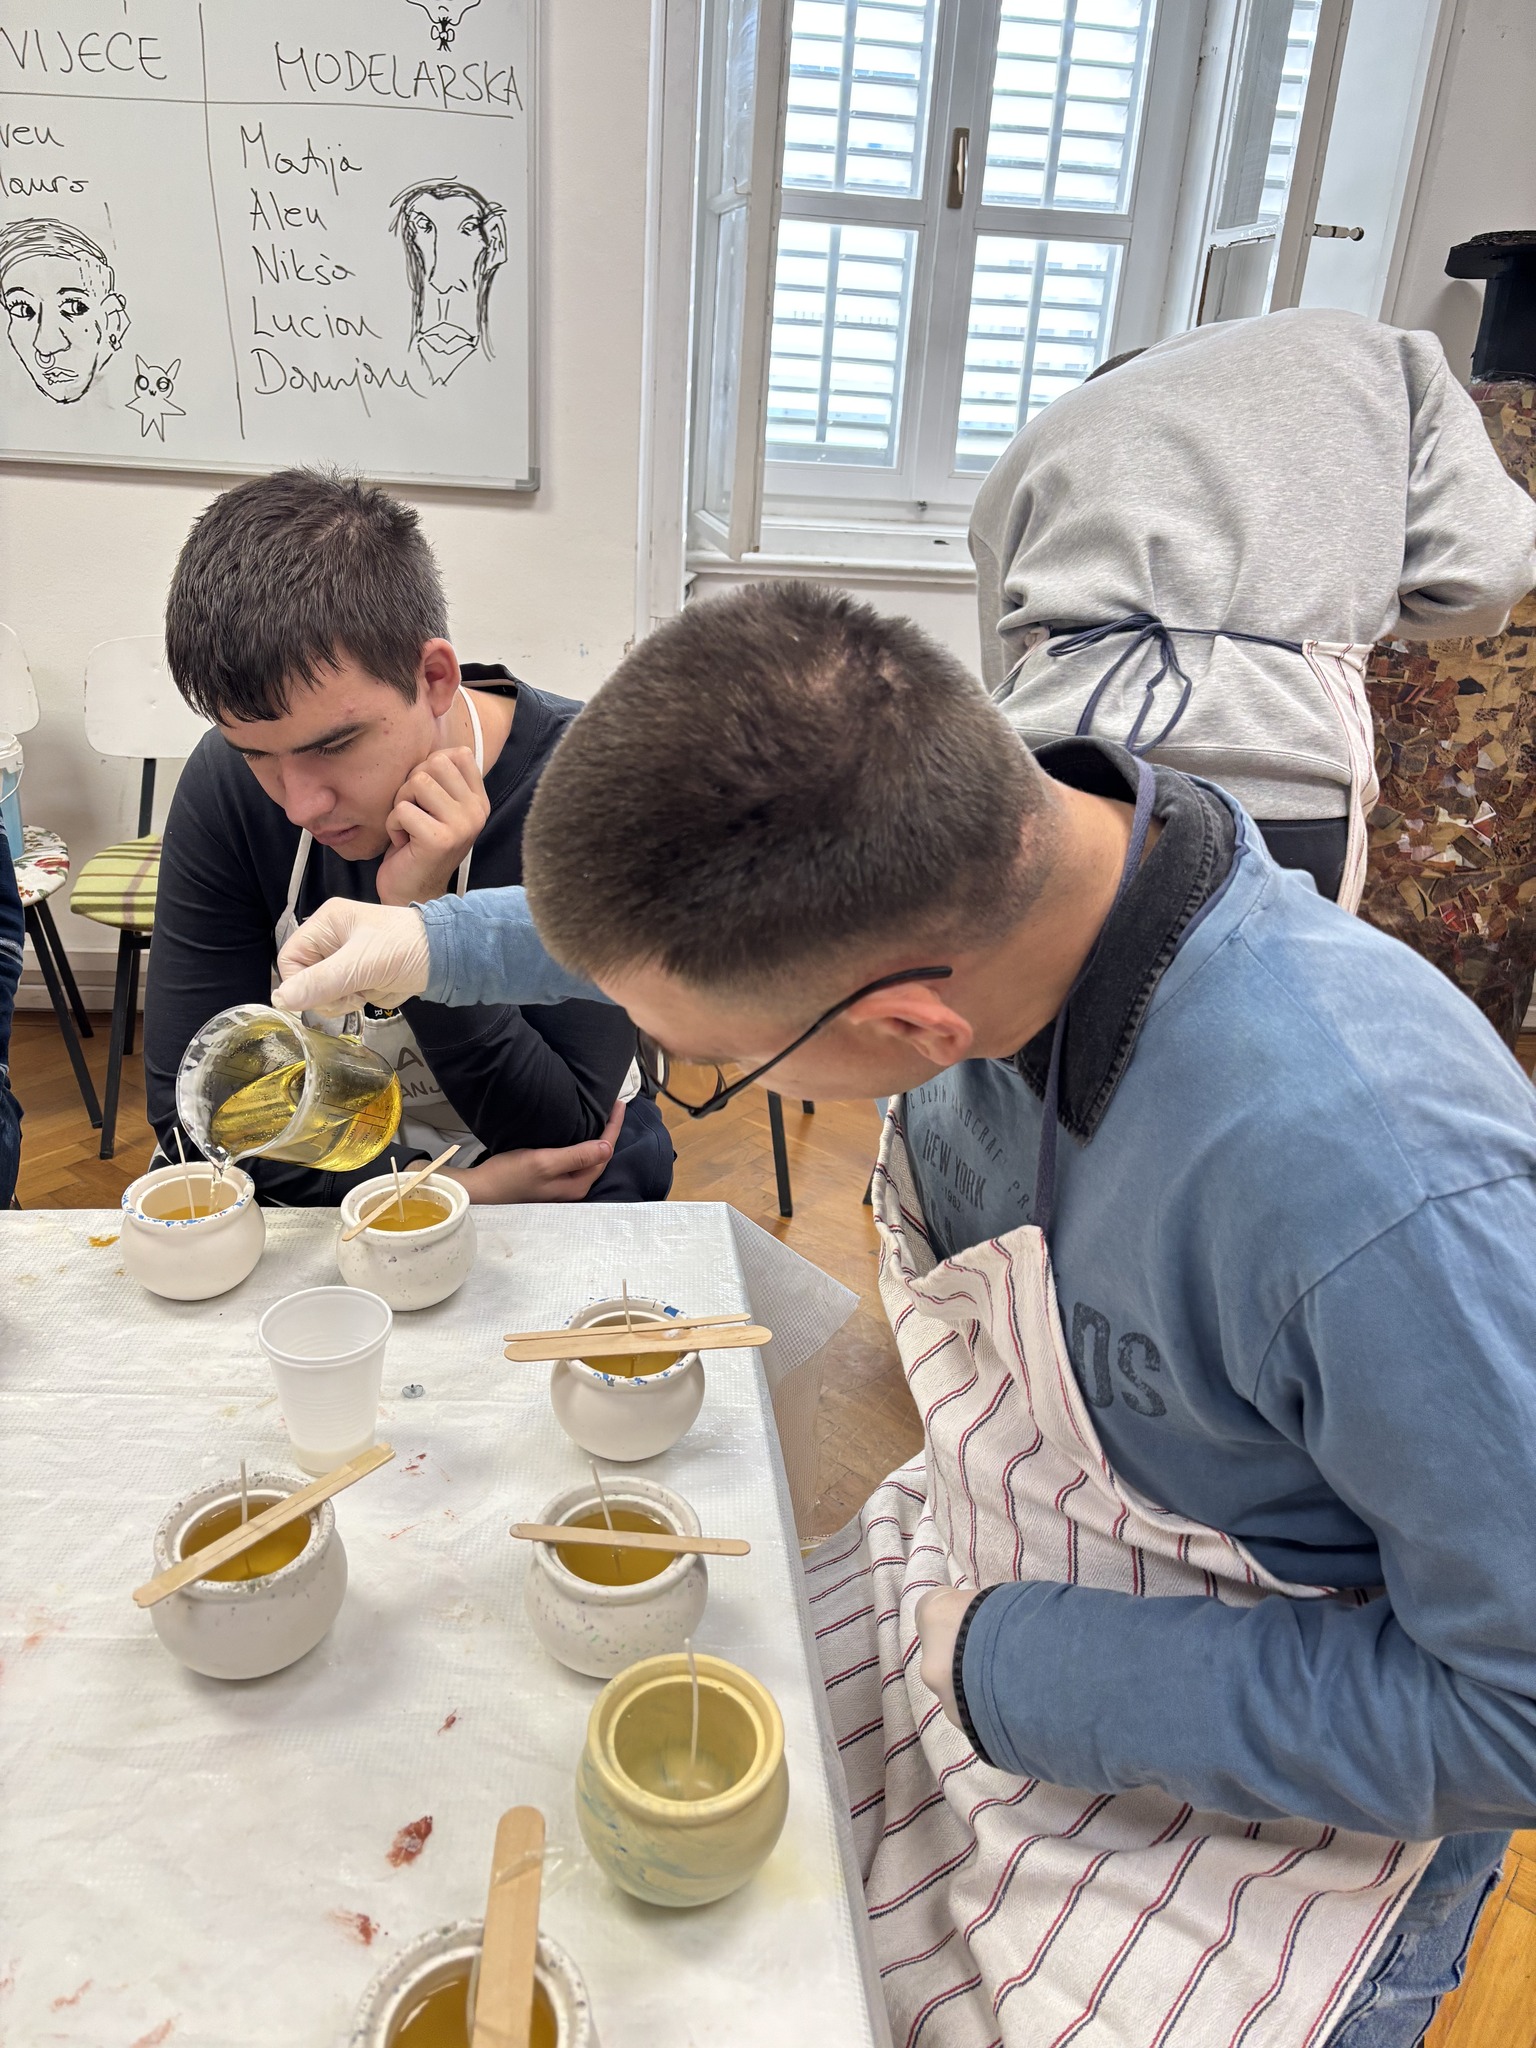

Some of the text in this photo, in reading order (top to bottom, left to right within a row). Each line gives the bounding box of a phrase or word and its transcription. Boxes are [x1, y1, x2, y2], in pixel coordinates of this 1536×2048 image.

[274, 41, 523, 110] MODELARSKA
[922, 1128, 986, 1211] NEW YORK
